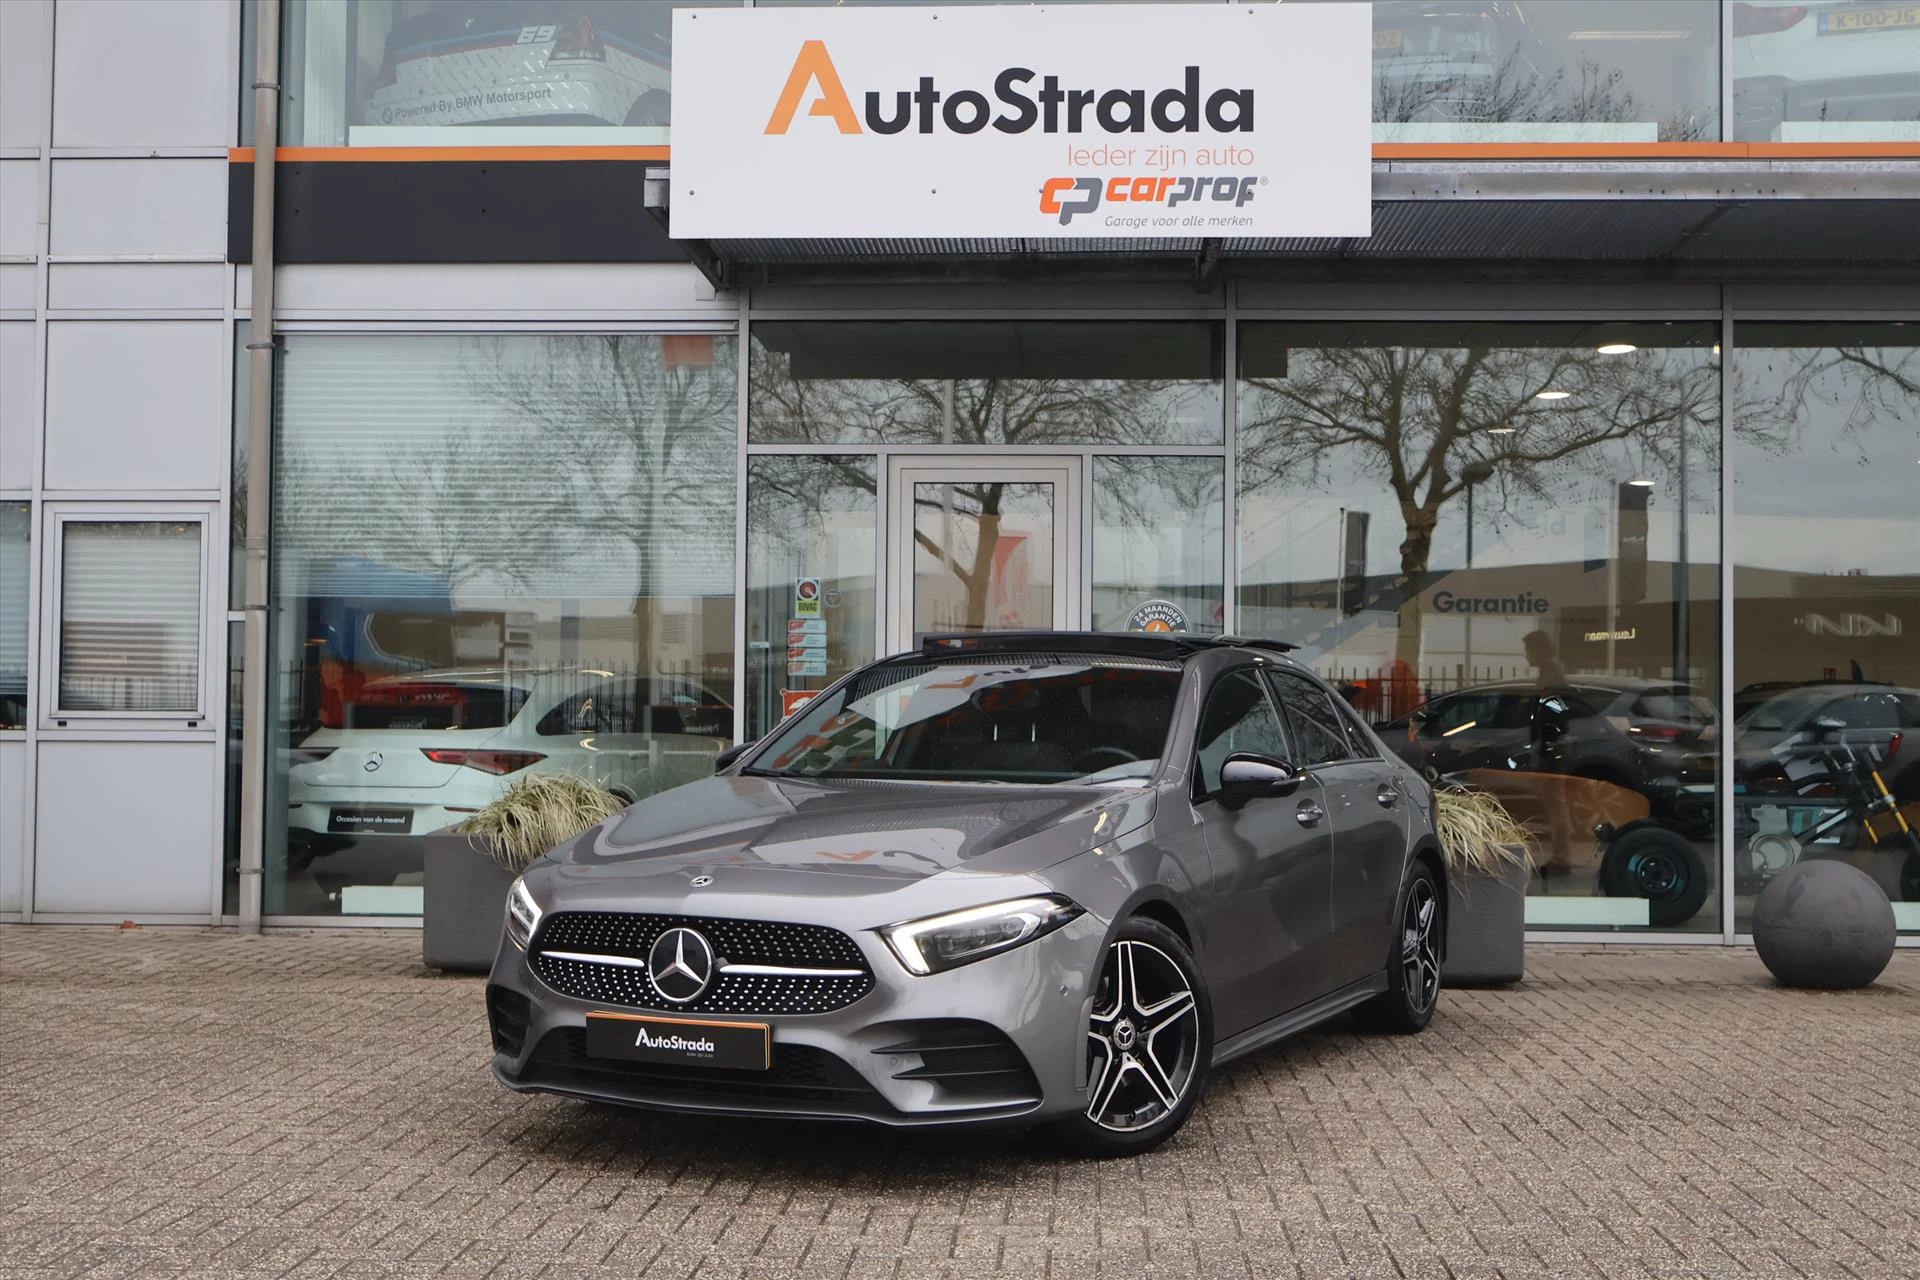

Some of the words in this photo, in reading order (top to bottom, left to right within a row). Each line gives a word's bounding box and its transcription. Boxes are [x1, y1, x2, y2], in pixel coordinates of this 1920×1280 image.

[516, 25, 556, 45] 69
[763, 40, 1255, 135] AutoStrada
[395, 102, 437, 119] Powered
[439, 99, 453, 114] By
[455, 95, 484, 108] BMW
[486, 88, 552, 106] Motorsport
[1067, 144, 1137, 167] Ieder
[1145, 144, 1187, 172] zijn
[1195, 146, 1255, 167] auto
[1105, 176, 1258, 208] carprof
[1104, 215, 1148, 230] Garage
[1152, 217, 1178, 227] voor
[1182, 215, 1203, 227] alle
[1208, 215, 1254, 227] merken
[798, 602, 818, 612] BOVAG
[1432, 590, 1549, 613] Garantie
[1133, 611, 1145, 623] 24
[1144, 605, 1182, 623] MAANDEN
[1140, 613, 1176, 628] GARANTIE
[336, 815, 362, 823] Occasion
[375, 815, 383, 823] de
[635, 1027, 715, 1052] AutoStrada
